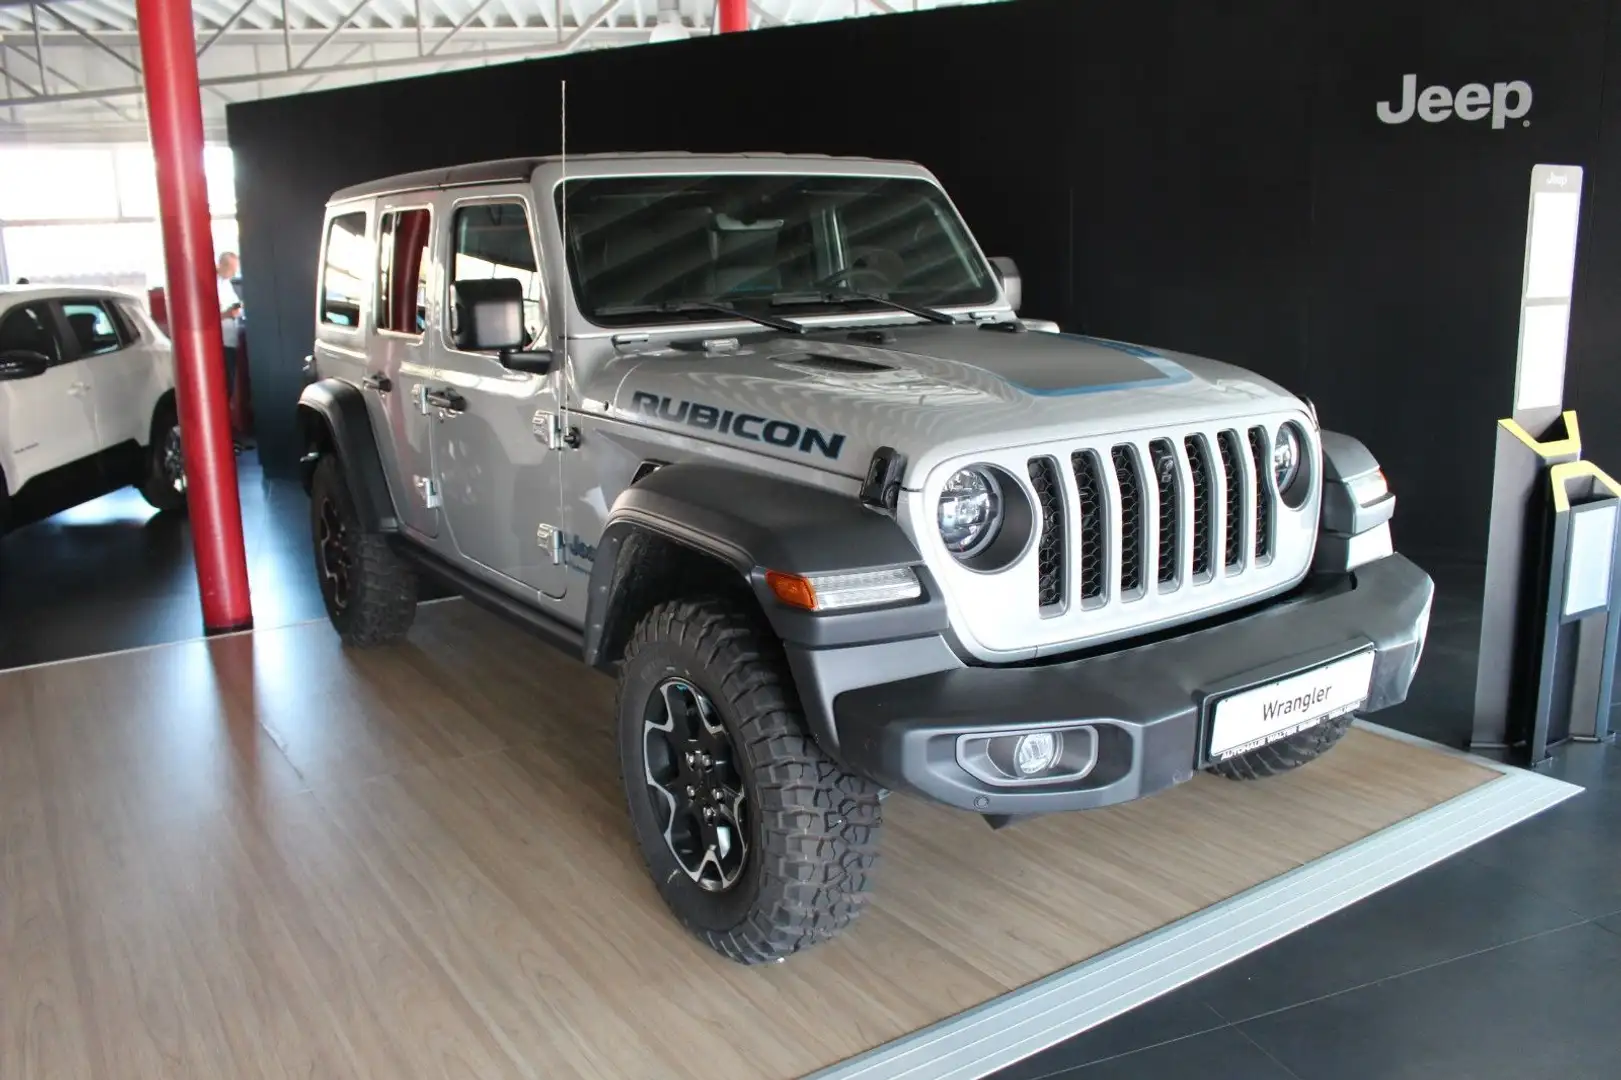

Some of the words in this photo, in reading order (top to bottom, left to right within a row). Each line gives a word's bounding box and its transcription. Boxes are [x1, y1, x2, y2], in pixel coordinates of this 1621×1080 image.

[1376, 73, 1533, 129] Jeep
[1546, 171, 1568, 188] Jeep
[631, 391, 846, 460] RUBICON
[1262, 686, 1332, 721] Wrangler
